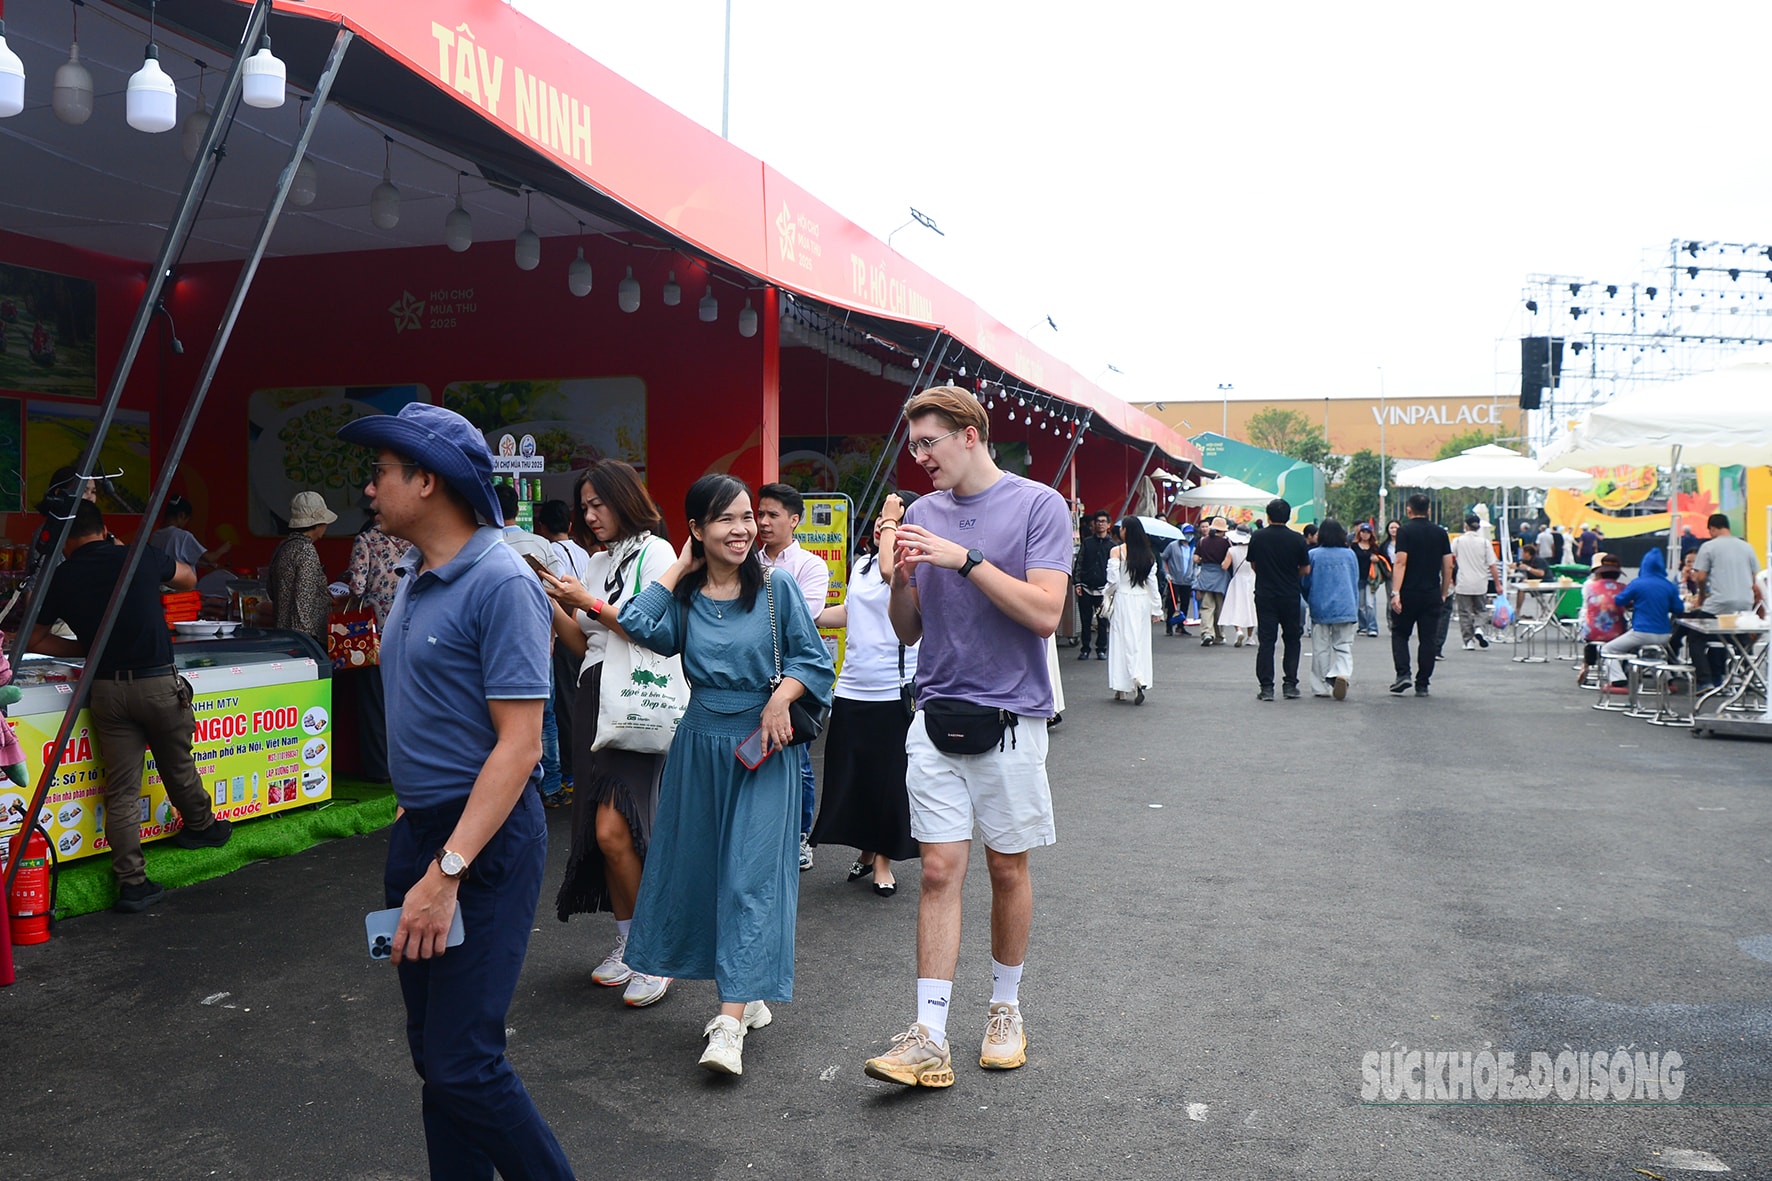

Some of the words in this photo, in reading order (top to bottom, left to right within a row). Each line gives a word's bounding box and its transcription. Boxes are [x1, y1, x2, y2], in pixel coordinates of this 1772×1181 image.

[432, 21, 504, 117] TÂY
[515, 66, 592, 166] NINH
[431, 290, 448, 301] HỘI
[450, 288, 474, 301] CHỢ
[851, 253, 868, 300] TP.
[870, 259, 887, 309] HỒ
[890, 277, 907, 315] CHÍ
[909, 288, 933, 321] MINH
[431, 303, 453, 313] MÙA
[456, 303, 478, 313] THU
[431, 318, 456, 328] 2025
[1371, 404, 1503, 425] VINPALACE
[521, 460, 531, 469] THU
[531, 460, 543, 469] 2025
[959, 519, 977, 528] EA7
[191, 700, 214, 712] NHH
[217, 697, 239, 708] MTV
[194, 713, 247, 743] NGỌC
[253, 706, 298, 733] FOOD
[63, 771, 77, 785] Số
[79, 771, 86, 782] 7
[193, 748, 218, 762] Thành
[220, 744, 235, 758] phố
[236, 743, 247, 755] Hà
[266, 737, 280, 751] Việt
[281, 736, 298, 747] Nam
[232, 799, 262, 817] QUỐC
